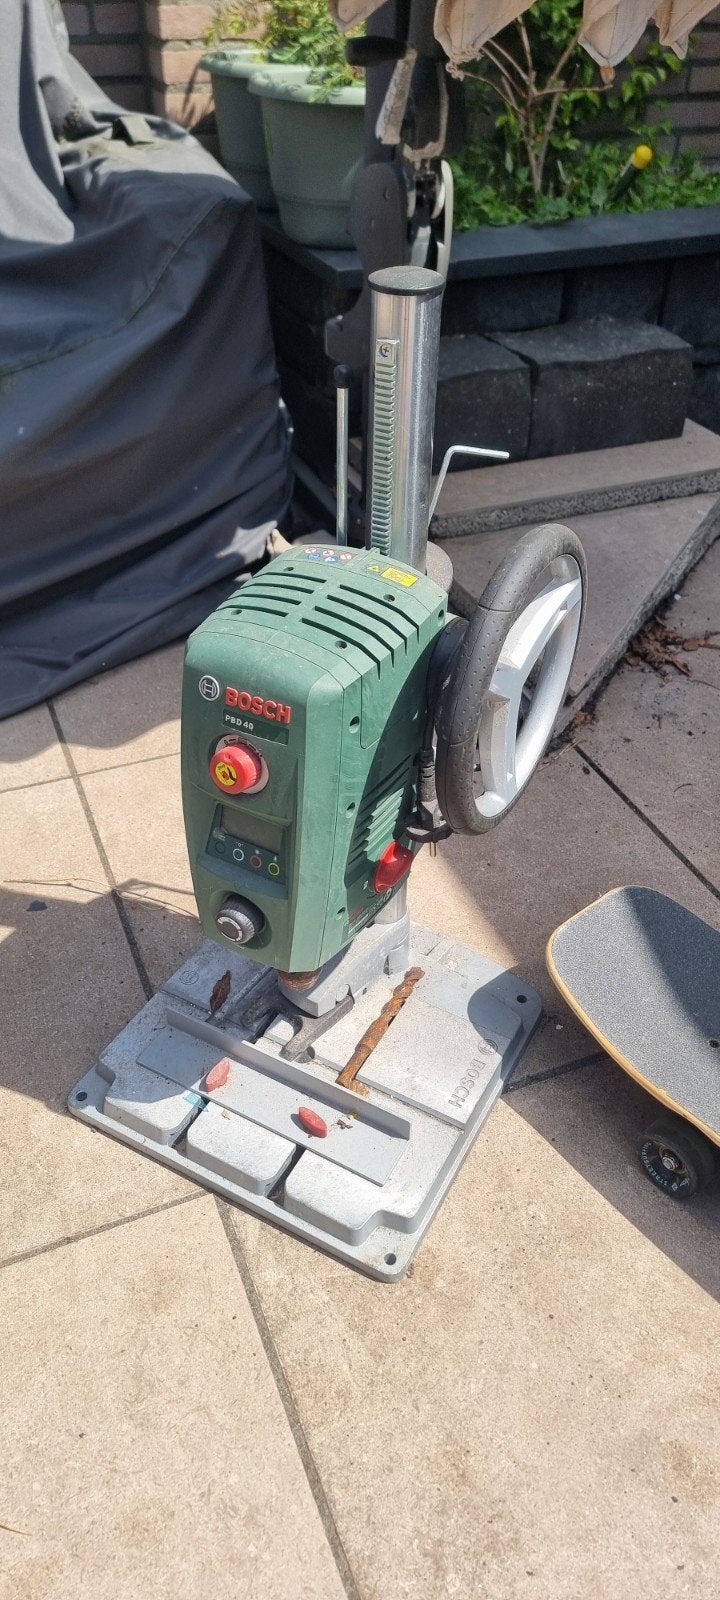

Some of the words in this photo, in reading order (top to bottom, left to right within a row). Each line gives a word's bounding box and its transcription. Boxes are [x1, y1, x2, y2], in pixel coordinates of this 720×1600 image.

[225, 686, 291, 724] BOSCH
[225, 714, 242, 726] PBD
[243, 721, 254, 730] 40
[448, 1058, 486, 1108] BOSCH
